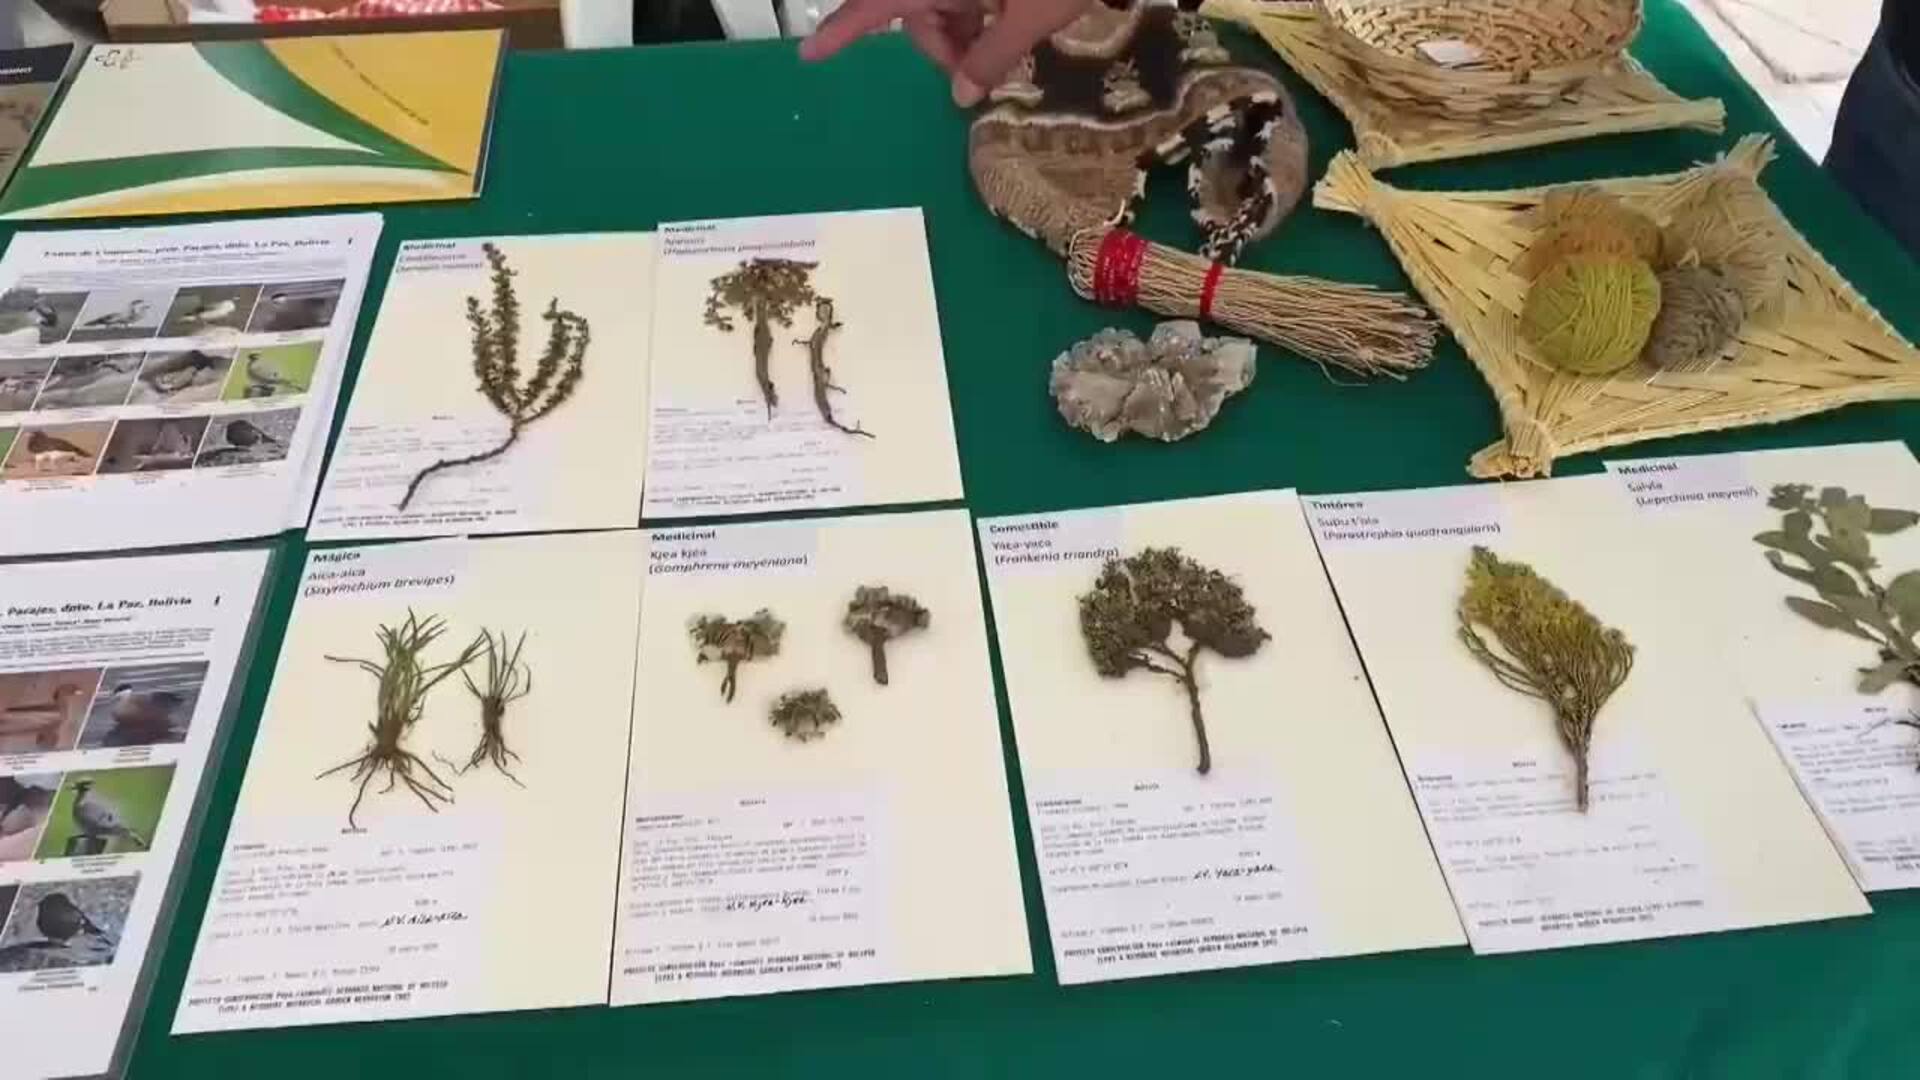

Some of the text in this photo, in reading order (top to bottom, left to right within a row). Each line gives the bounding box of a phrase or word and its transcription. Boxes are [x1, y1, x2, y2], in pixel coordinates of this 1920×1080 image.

[1618, 461, 1679, 475] Medicinal
[1627, 480, 1663, 493] Salvia
[990, 520, 1059, 534] Comestible
[652, 530, 716, 542] Medicinal
[313, 550, 361, 563] Mágica
[650, 550, 677, 561] Kjea
[995, 547, 1119, 566] (Frankenia triandra)
[649, 561, 730, 576] (Gomphrena
[394, 574, 456, 590] brevipes)
[97, 601, 114, 611] La
